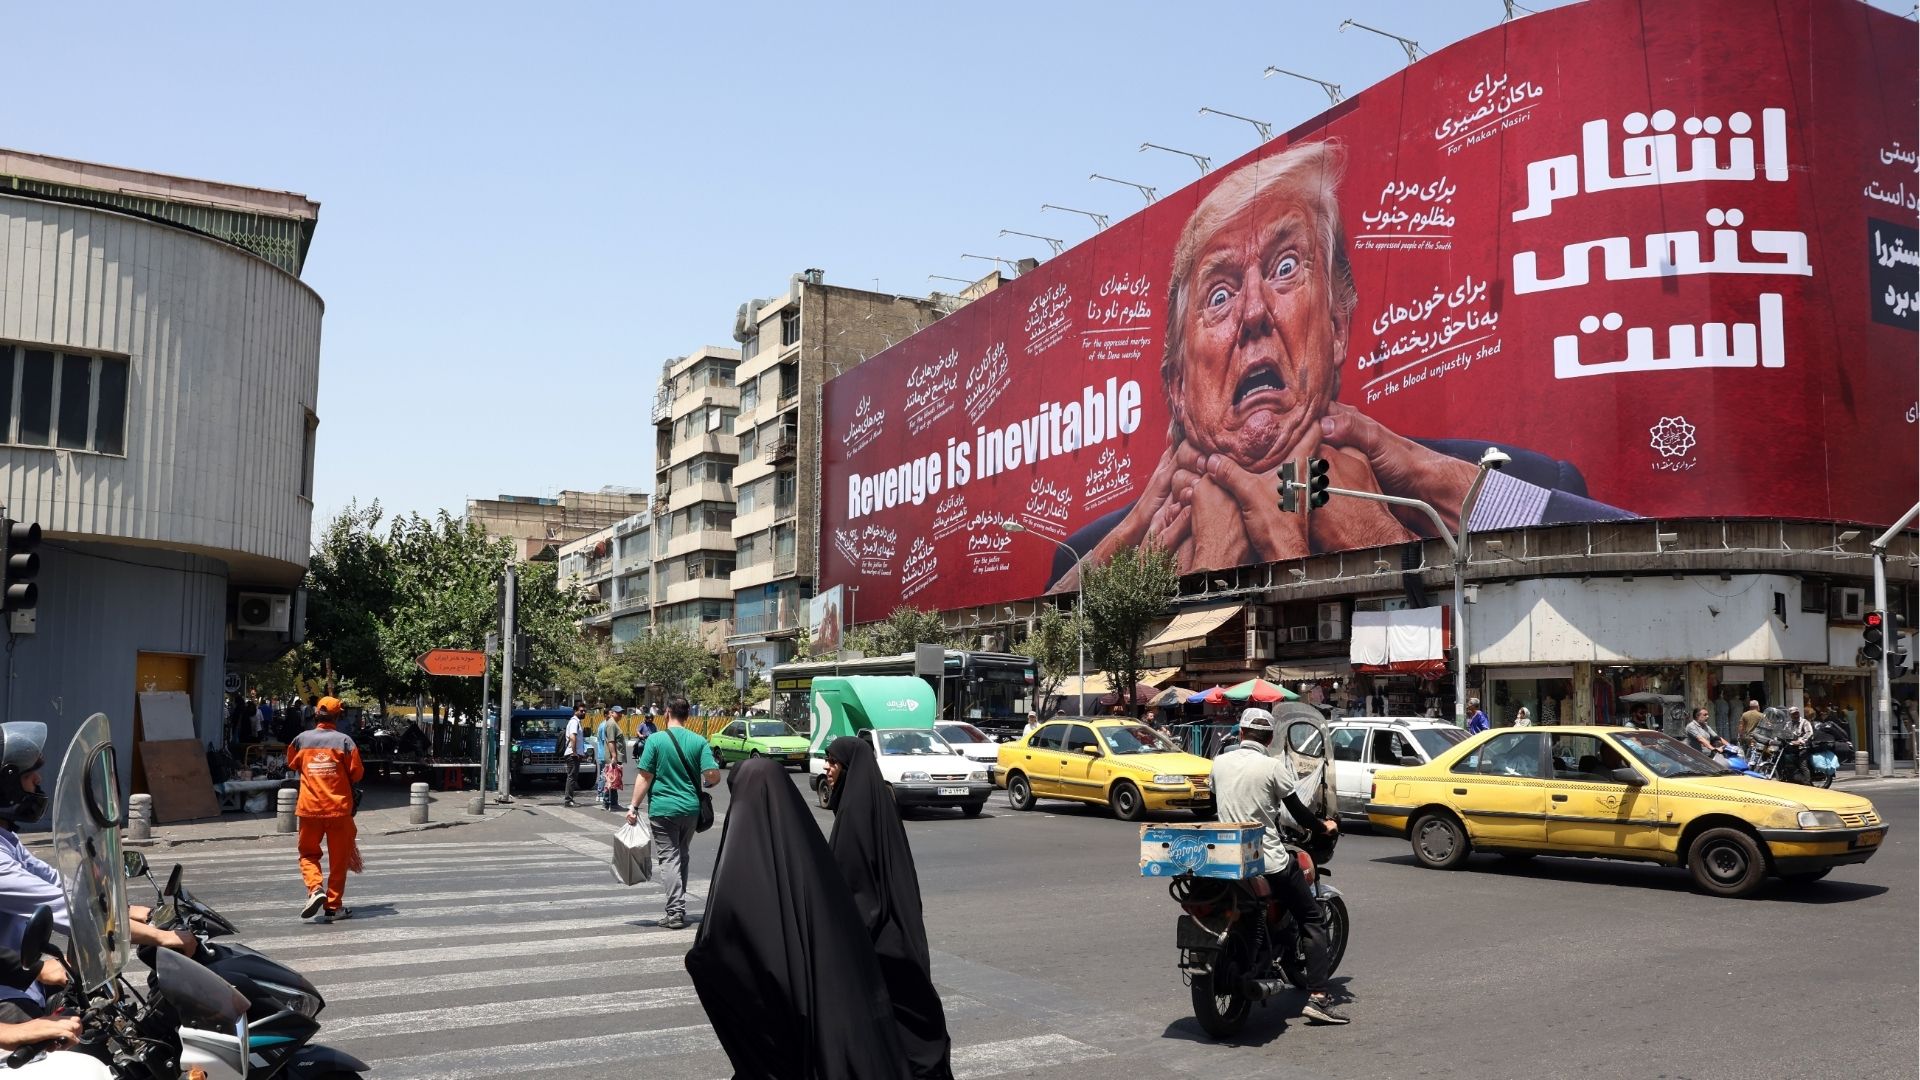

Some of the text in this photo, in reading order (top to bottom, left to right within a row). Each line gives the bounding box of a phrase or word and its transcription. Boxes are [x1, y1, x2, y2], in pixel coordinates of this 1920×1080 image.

[1468, 73, 1507, 102] برای
[1435, 81, 1543, 140] ماکان نصیری
[1447, 112, 1531, 156] For Makan Nasiri
[1512, 108, 1789, 222] انتقام
[1380, 176, 1456, 205] برای مردم
[1362, 205, 1455, 232] مظلوم جنوب
[1355, 240, 1451, 251] For the oppressed people of the South
[1513, 208, 1812, 295] حتمی
[1053, 282, 1067, 300] برای
[1100, 272, 1150, 296] برای شهدای
[1448, 275, 1487, 308] برای
[1029, 296, 1039, 312] که
[1087, 300, 1151, 325] مظلوم ناو دنا
[1082, 336, 1151, 350] For the oppressed martyrs
[1553, 293, 1786, 379] است
[945, 348, 959, 368] برای
[966, 342, 1004, 390] برای آنان که
[999, 353, 1008, 376] زیر
[1089, 350, 1096, 361] of
[1097, 351, 1105, 360] the
[907, 366, 918, 388] که
[1367, 338, 1501, 404] For the blood unjustly shed
[856, 395, 871, 417] برای
[848, 452, 942, 520] Revenge
[947, 437, 971, 489] is
[977, 376, 1142, 481] inevitable
[1099, 447, 1115, 465] برای
[1086, 453, 1131, 487] زهرا کوچولو
[1660, 458, 1674, 470] منطقه
[1672, 456, 1697, 471] شهرداری
[1031, 477, 1057, 497] مادران
[1057, 487, 1073, 507] برای
[1085, 483, 1105, 497] ماهه
[954, 494, 965, 508] برای
[1026, 496, 1068, 520] داغدار ایران
[967, 510, 1004, 531] دادخواهی
[886, 528, 897, 544] برای
[911, 536, 925, 553] برای
[969, 532, 1012, 551] خون رهبرم
